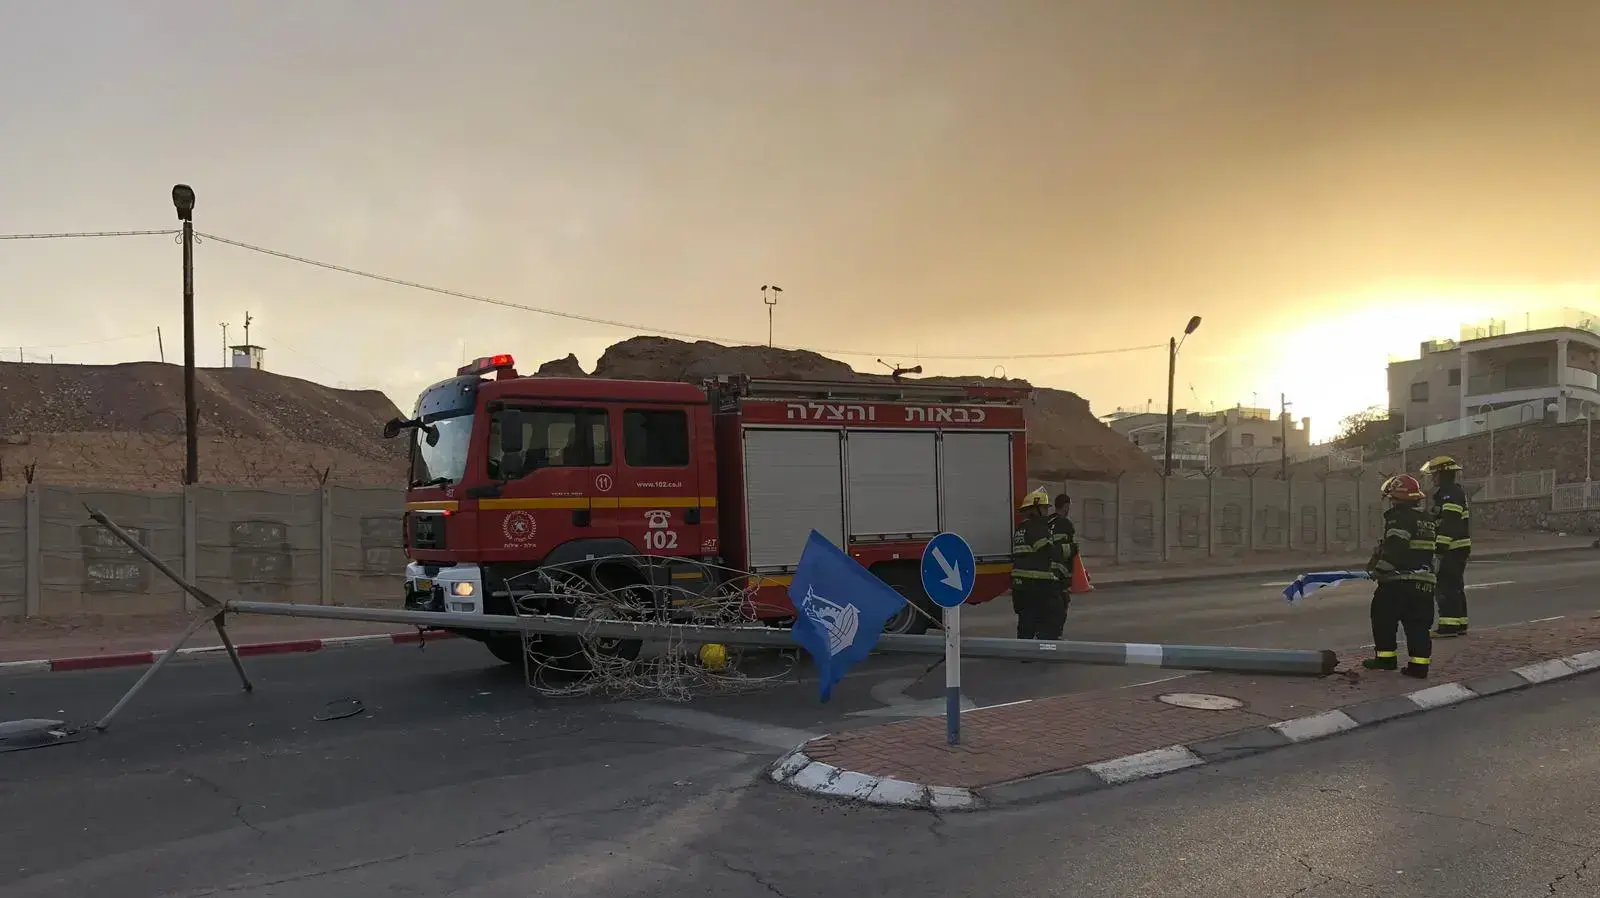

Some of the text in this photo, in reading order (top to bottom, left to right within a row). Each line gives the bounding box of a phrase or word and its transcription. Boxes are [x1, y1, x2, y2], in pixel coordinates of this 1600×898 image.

[787, 402, 986, 423] כבאות והצלה
[599, 476, 609, 489] 11
[643, 530, 678, 550] 102
